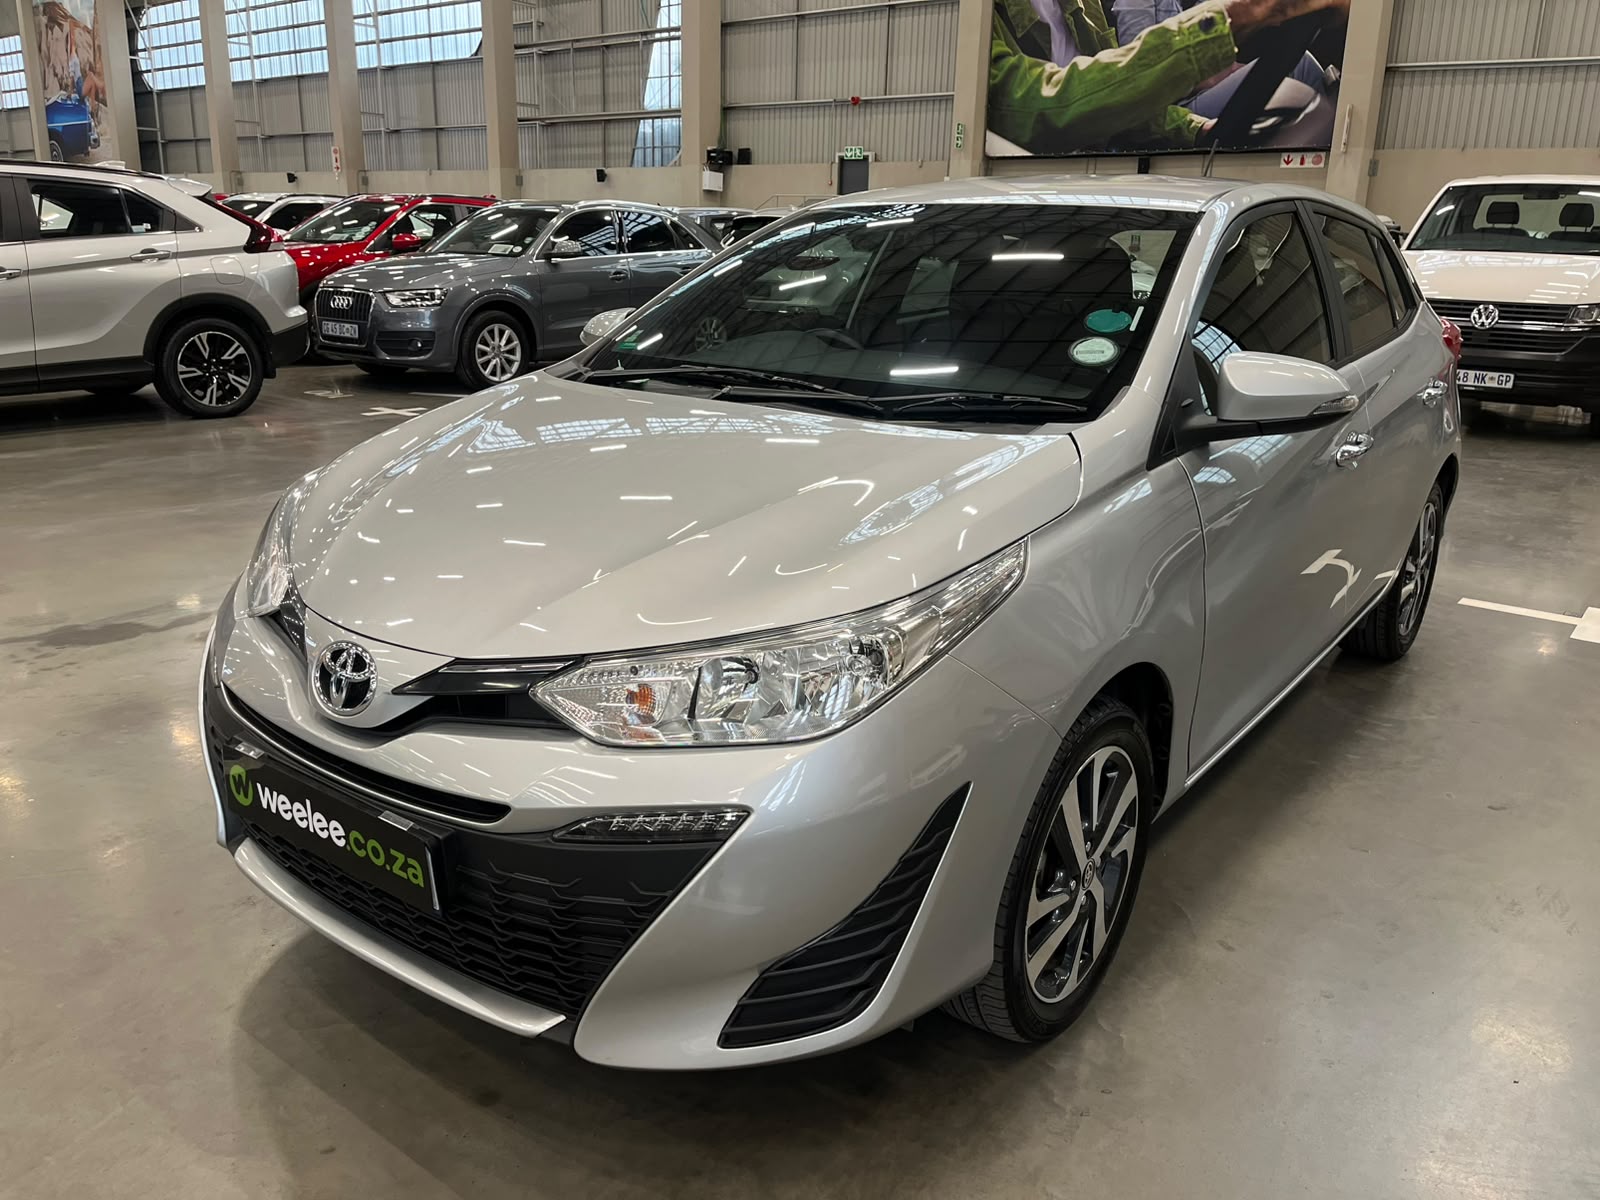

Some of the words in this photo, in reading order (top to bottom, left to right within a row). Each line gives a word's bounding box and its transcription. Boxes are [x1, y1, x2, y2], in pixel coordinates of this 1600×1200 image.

[1473, 372, 1488, 385] NK
[1497, 374, 1511, 387] GP
[256, 782, 424, 888] weelee.co.za
